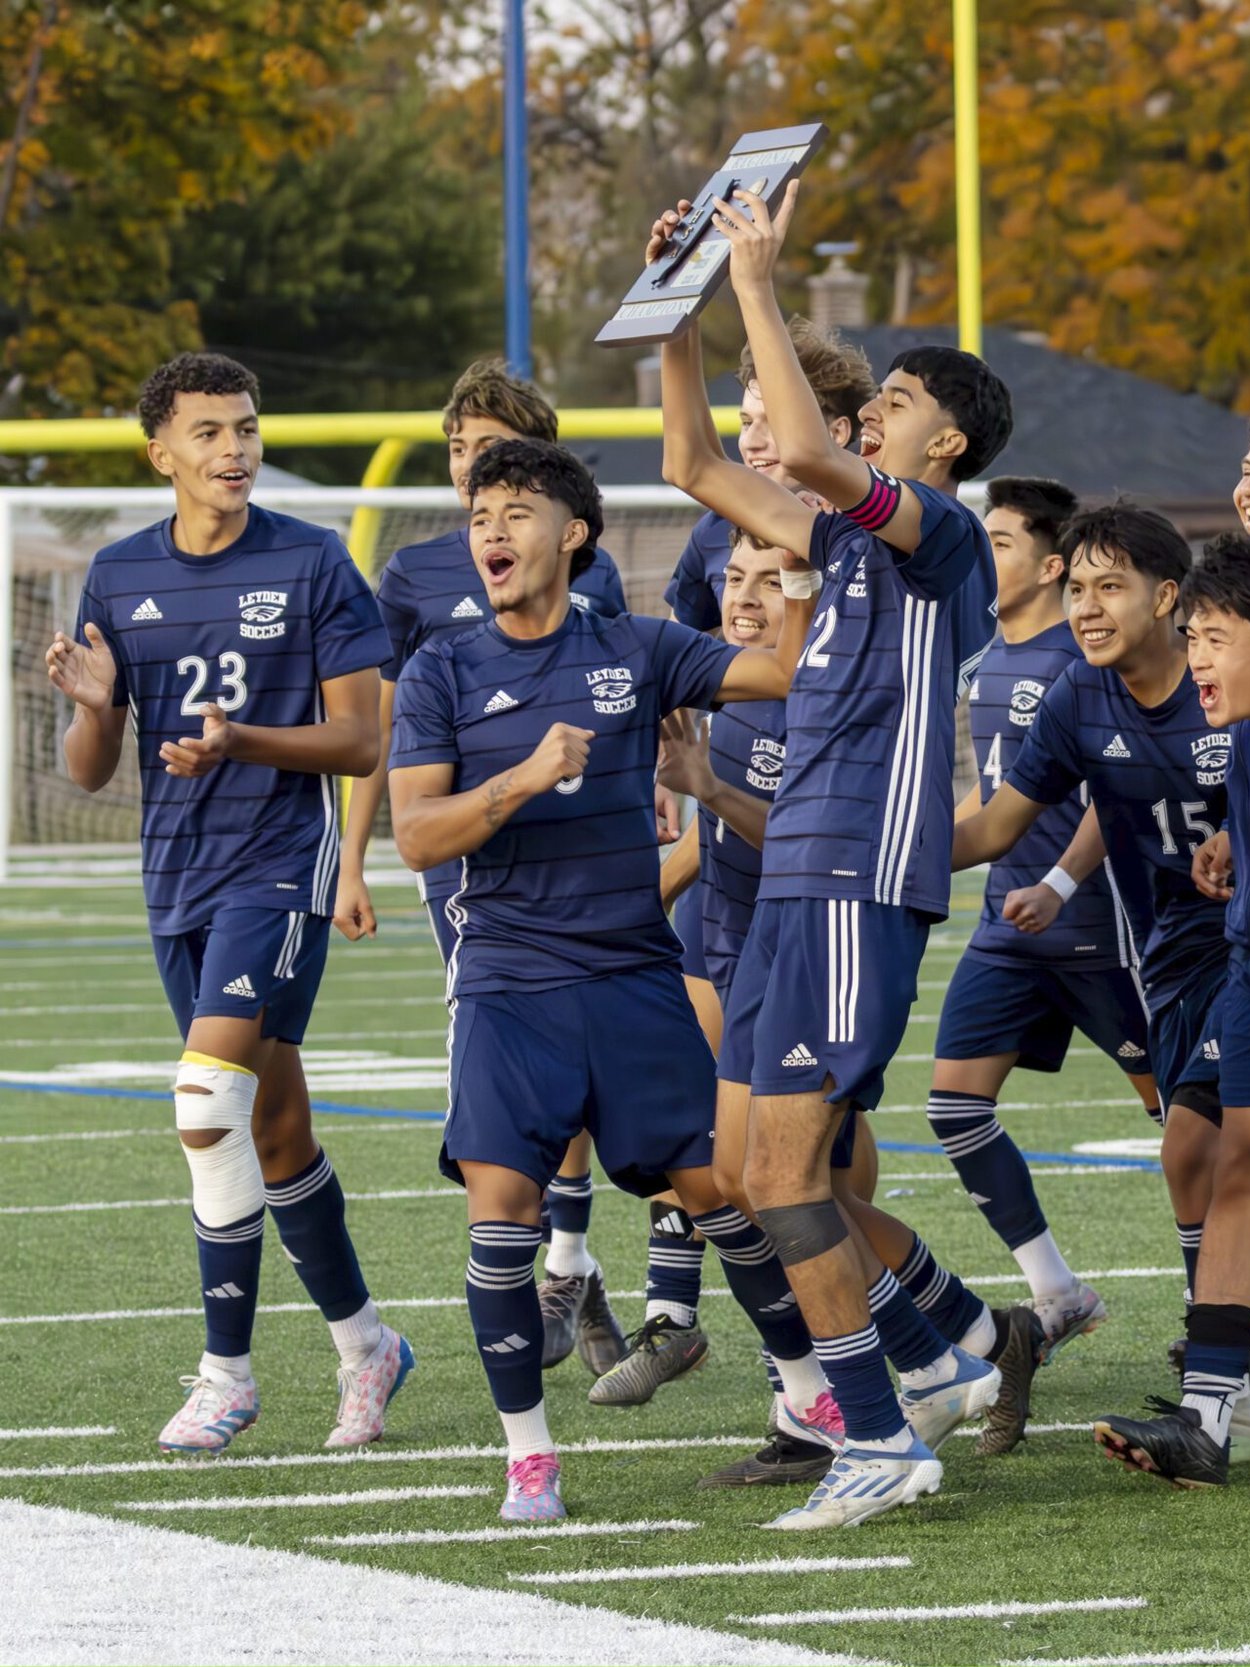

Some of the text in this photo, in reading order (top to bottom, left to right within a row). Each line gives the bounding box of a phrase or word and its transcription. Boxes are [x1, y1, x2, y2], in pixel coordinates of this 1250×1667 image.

[238, 591, 287, 608] LEYDEN
[131, 611, 162, 620] adidas
[451, 608, 483, 618] adidas
[240, 622, 285, 639] SOCCER
[176, 651, 248, 716] 23
[585, 667, 632, 686] LEYDEN
[484, 700, 518, 713] adidas
[593, 695, 636, 714] SOCCER
[983, 732, 1002, 789] 4
[1103, 750, 1131, 758] adidas
[1196, 768, 1226, 786] SOCC
[1152, 799, 1216, 855] 15
[223, 986, 256, 998] adidas
[781, 1058, 818, 1067] adidas
